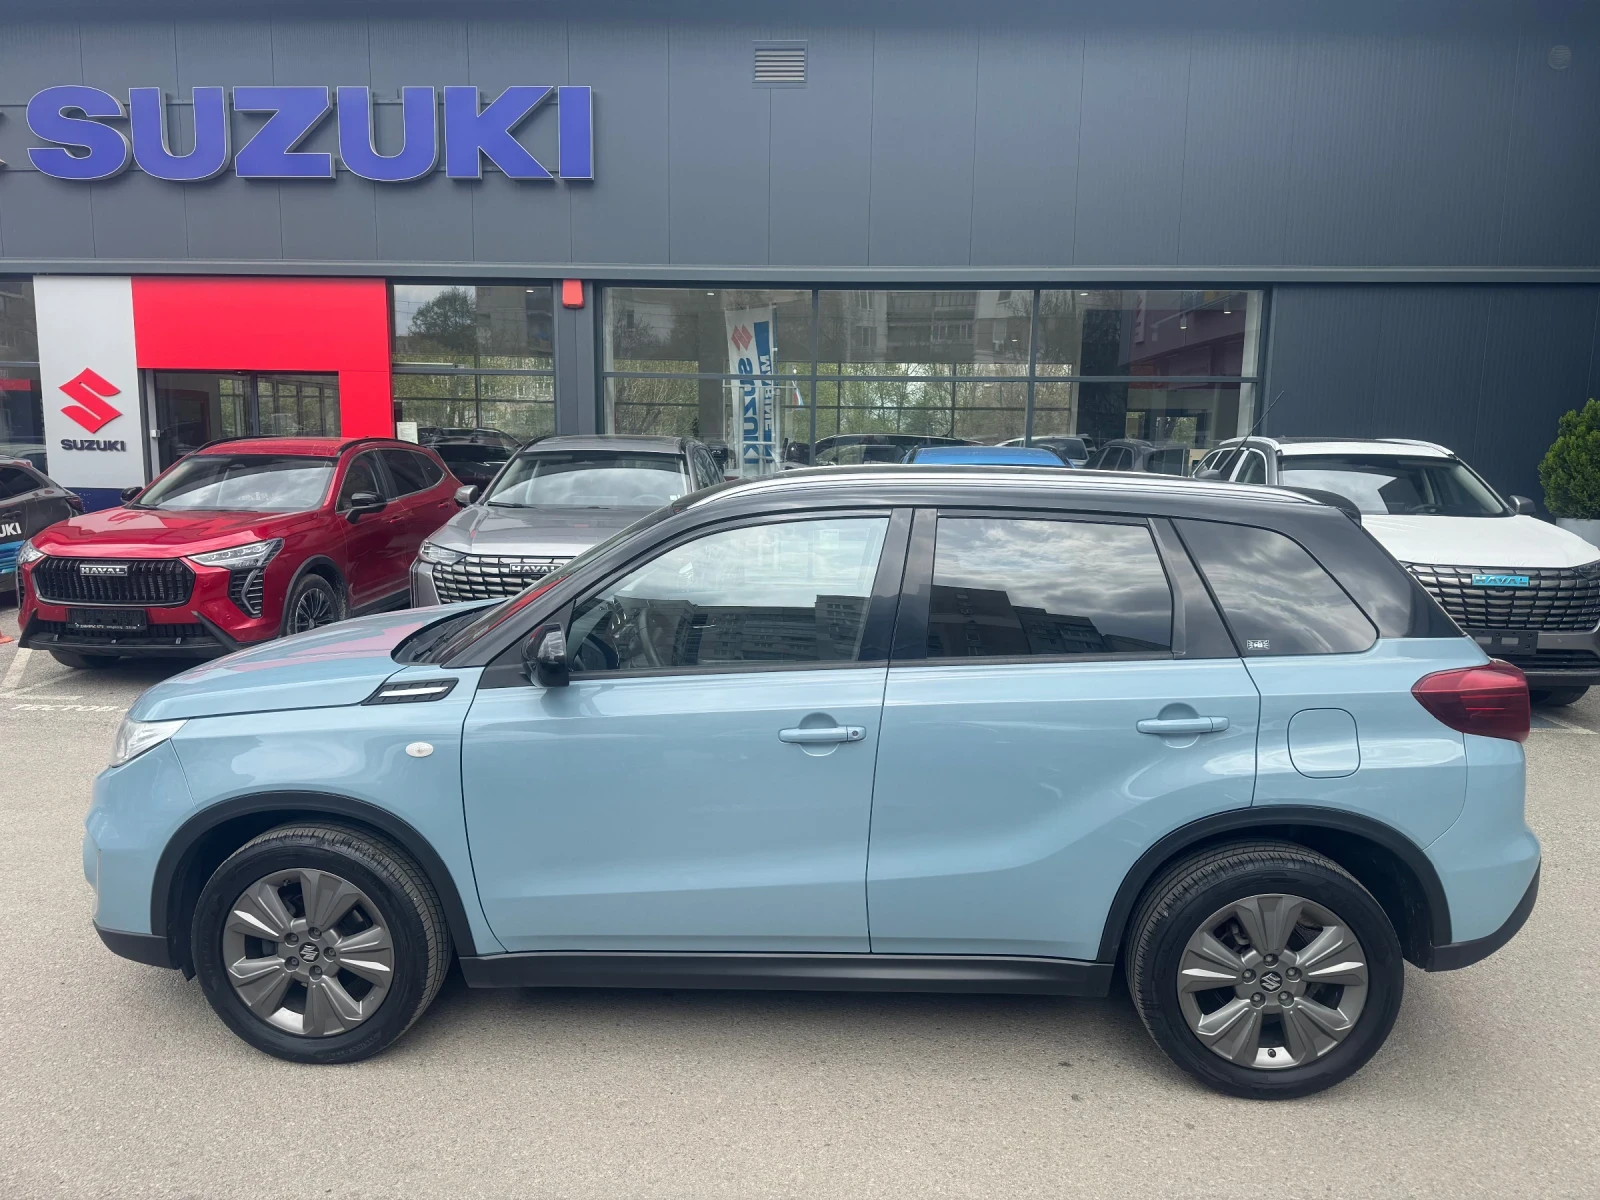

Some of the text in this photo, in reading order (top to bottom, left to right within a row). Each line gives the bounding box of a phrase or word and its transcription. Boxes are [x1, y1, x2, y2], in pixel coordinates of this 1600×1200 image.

[26, 84, 594, 182] SUZUKI
[60, 438, 127, 452] SUZUKI
[81, 566, 126, 575] HAVAL
[1475, 575, 1528, 586] HAVAL
